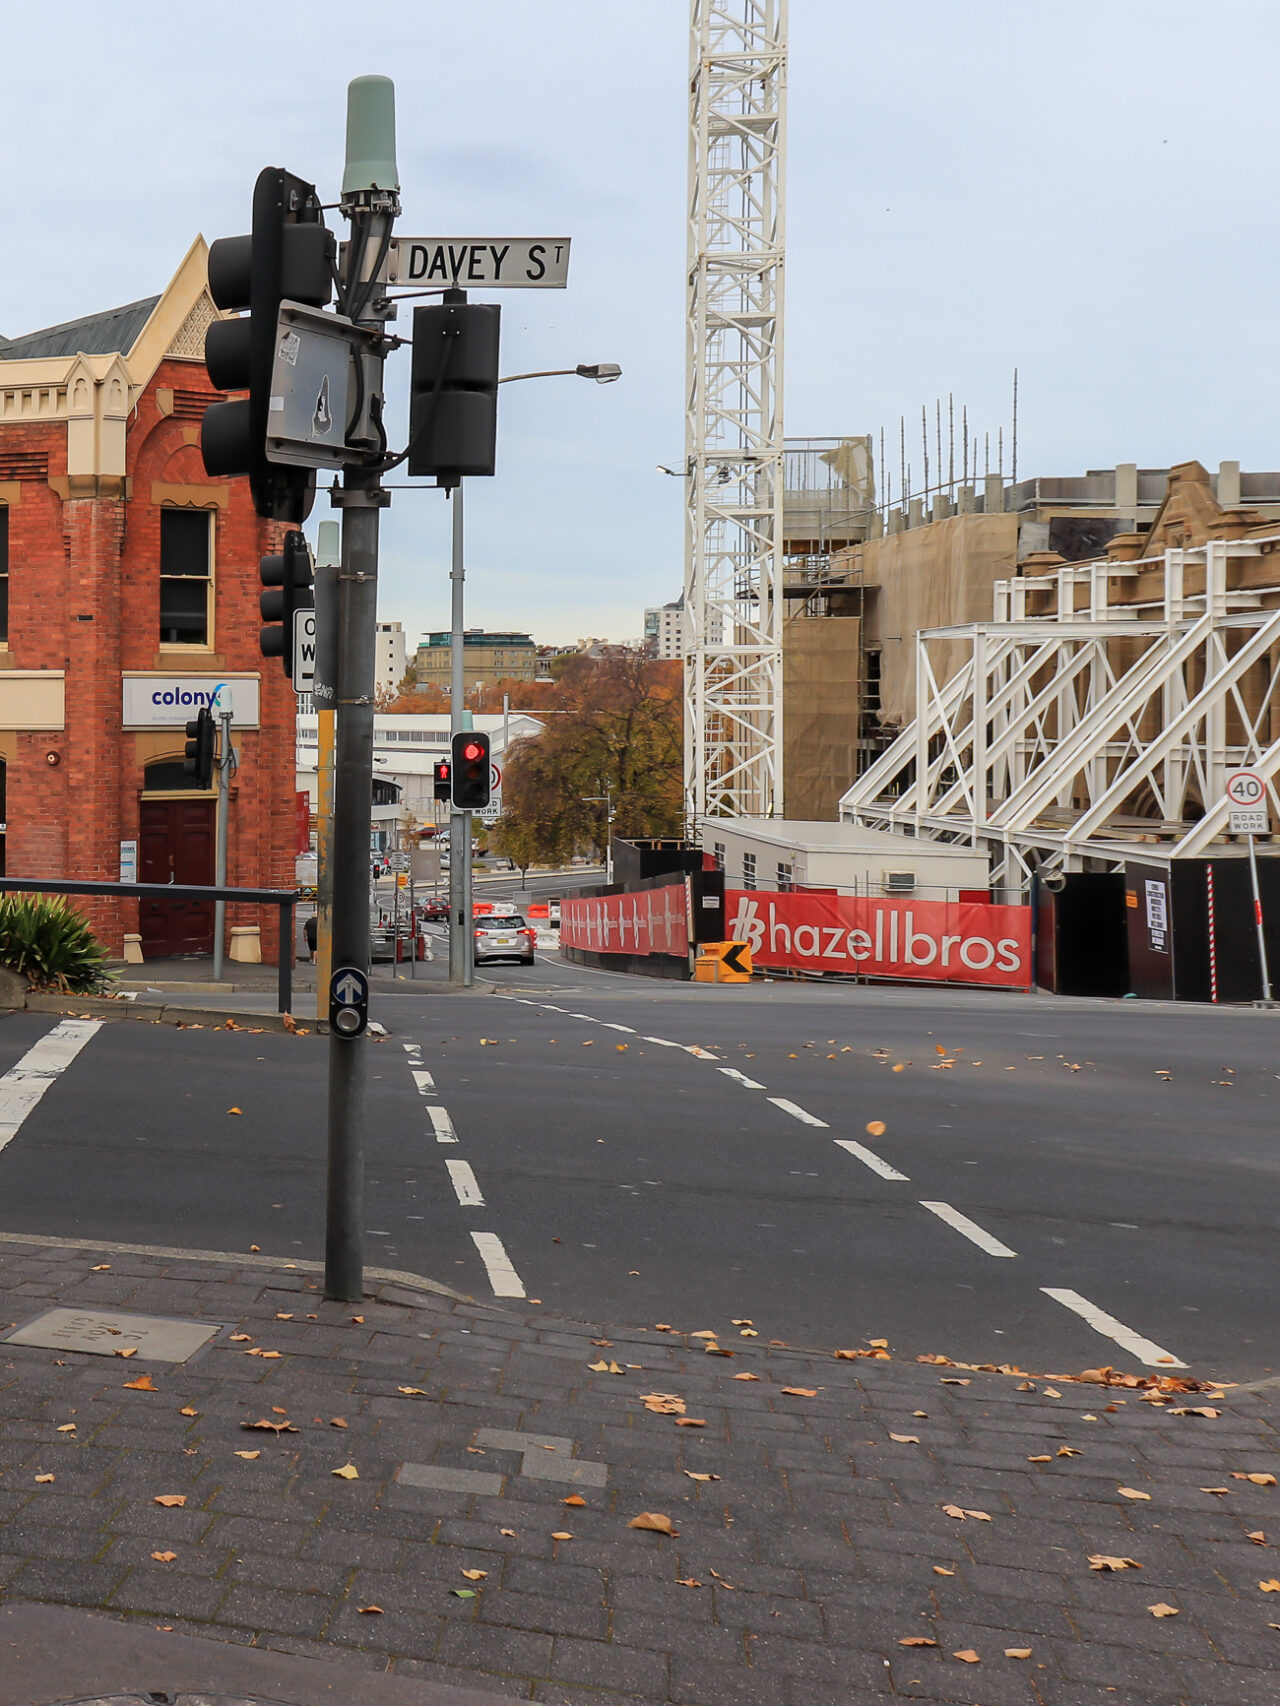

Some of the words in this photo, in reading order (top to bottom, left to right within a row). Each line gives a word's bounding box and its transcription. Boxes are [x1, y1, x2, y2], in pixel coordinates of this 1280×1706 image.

[408, 244, 510, 280] DAVEY
[152, 686, 217, 710] colony
[1232, 781, 1259, 797] 40
[1234, 822, 1264, 830] WORK
[769, 901, 1021, 973] hazellbros
